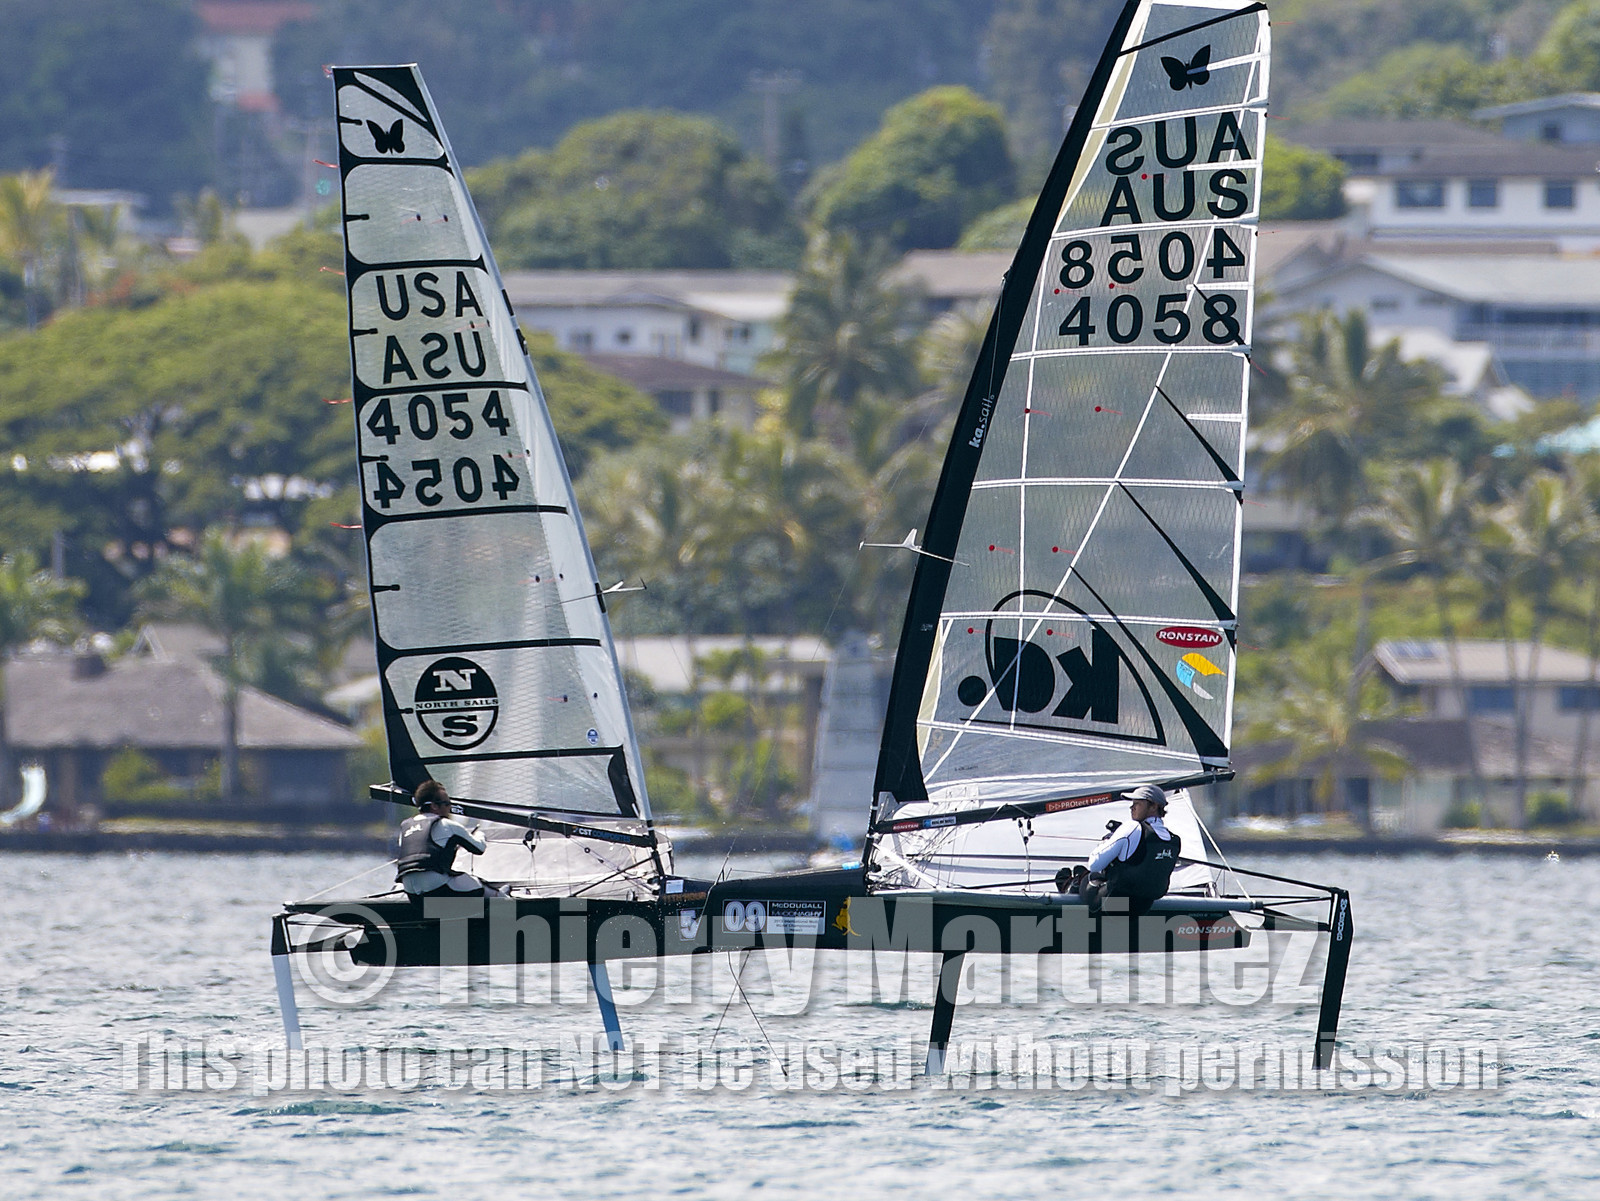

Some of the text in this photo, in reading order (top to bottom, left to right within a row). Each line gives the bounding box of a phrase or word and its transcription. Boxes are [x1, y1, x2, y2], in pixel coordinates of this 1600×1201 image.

[1100, 169, 1249, 227] AUS
[376, 271, 483, 321] USA
[1058, 293, 1241, 346] 4058
[366, 390, 510, 445] 4054
[1158, 630, 1219, 643] RONSTAN
[432, 668, 477, 693] N
[415, 698, 499, 710] NORTH SAILS
[441, 714, 479, 738] S
[578, 827, 593, 837] CST
[724, 901, 767, 932] 09
[1177, 926, 1237, 935] RONSTAN
